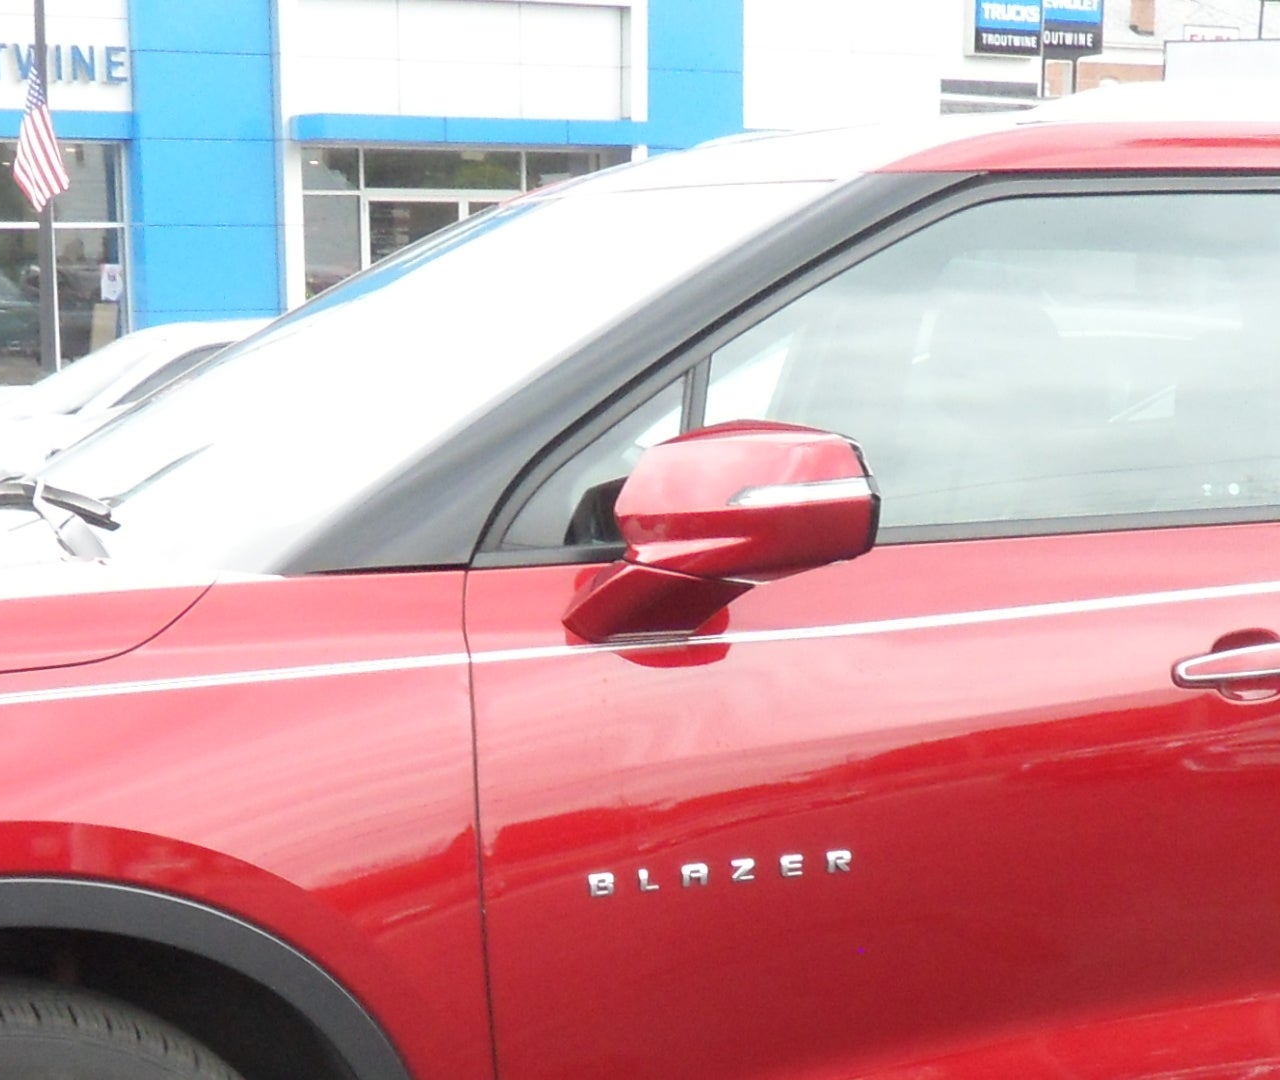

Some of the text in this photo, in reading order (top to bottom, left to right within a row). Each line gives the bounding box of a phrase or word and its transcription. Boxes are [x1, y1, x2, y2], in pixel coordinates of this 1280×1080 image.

[981, 3, 1040, 23] TRUCKS
[982, 33, 1038, 48] TROUTWINE
[1043, 30, 1094, 47] OUTWINE
[587, 848, 852, 897] BLAZER
